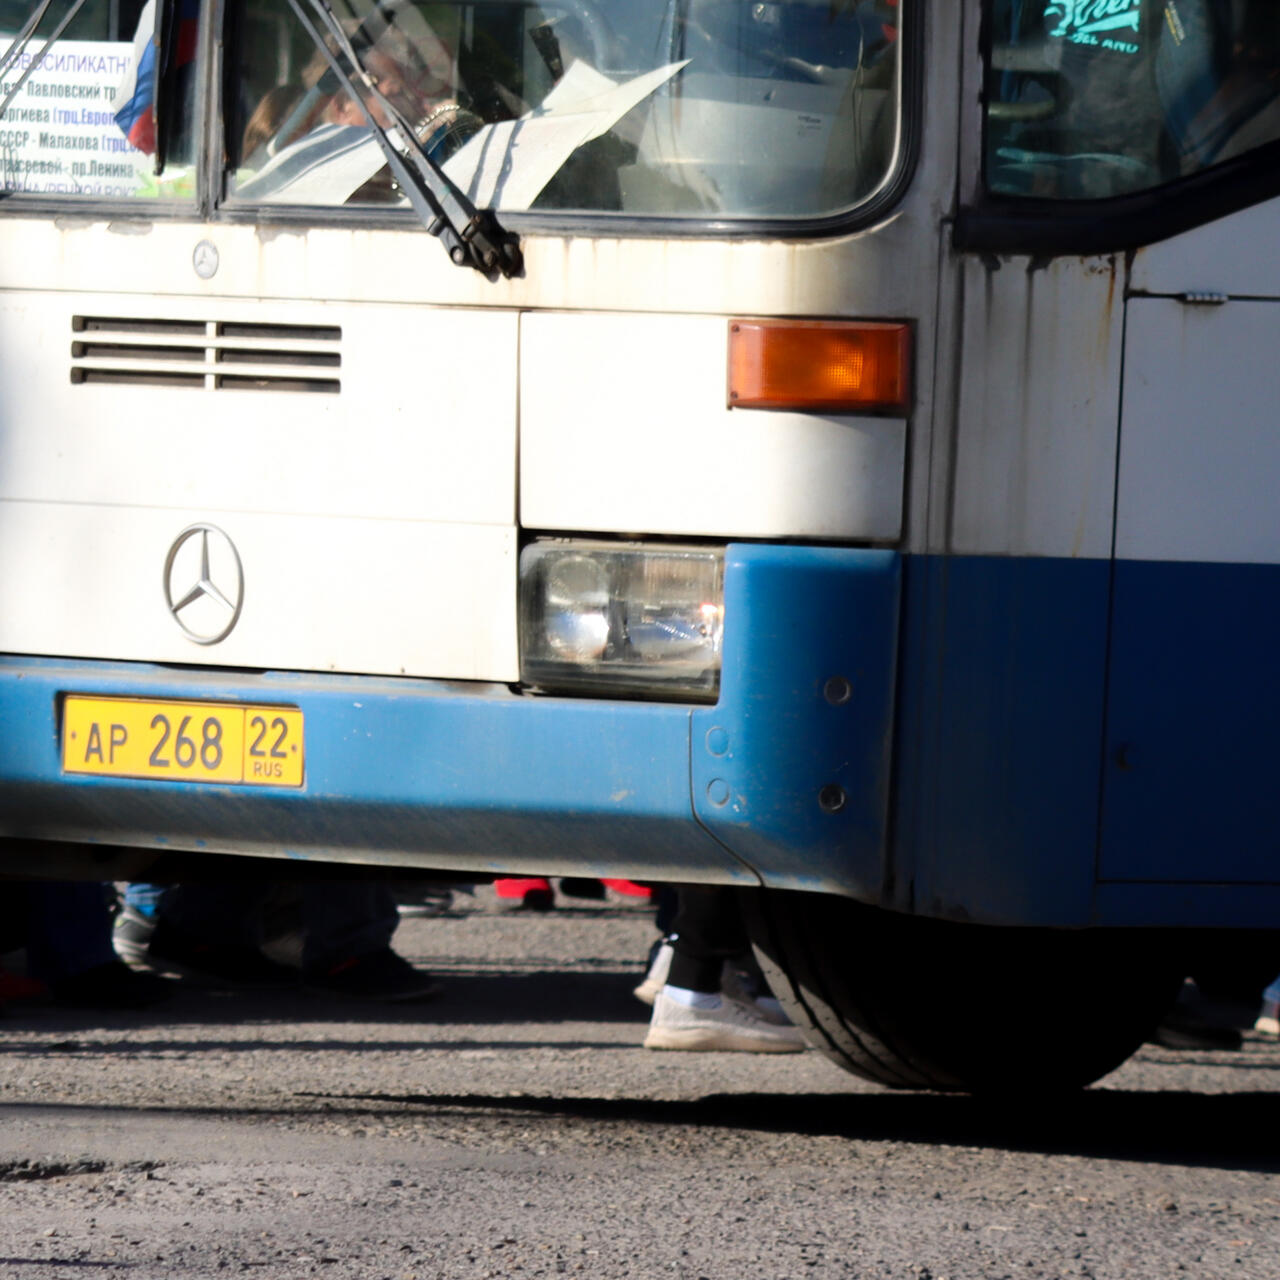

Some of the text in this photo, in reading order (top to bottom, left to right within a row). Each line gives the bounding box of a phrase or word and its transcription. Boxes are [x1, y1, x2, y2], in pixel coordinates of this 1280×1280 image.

[26, 80, 100, 101] Павловский
[53, 106, 116, 126] (трц.Европ
[39, 132, 99, 151] Малахова
[72, 160, 134, 179] пр.Ленина
[148, 713, 224, 770] 268
[249, 716, 289, 759] 22
[252, 760, 284, 778] RUS
